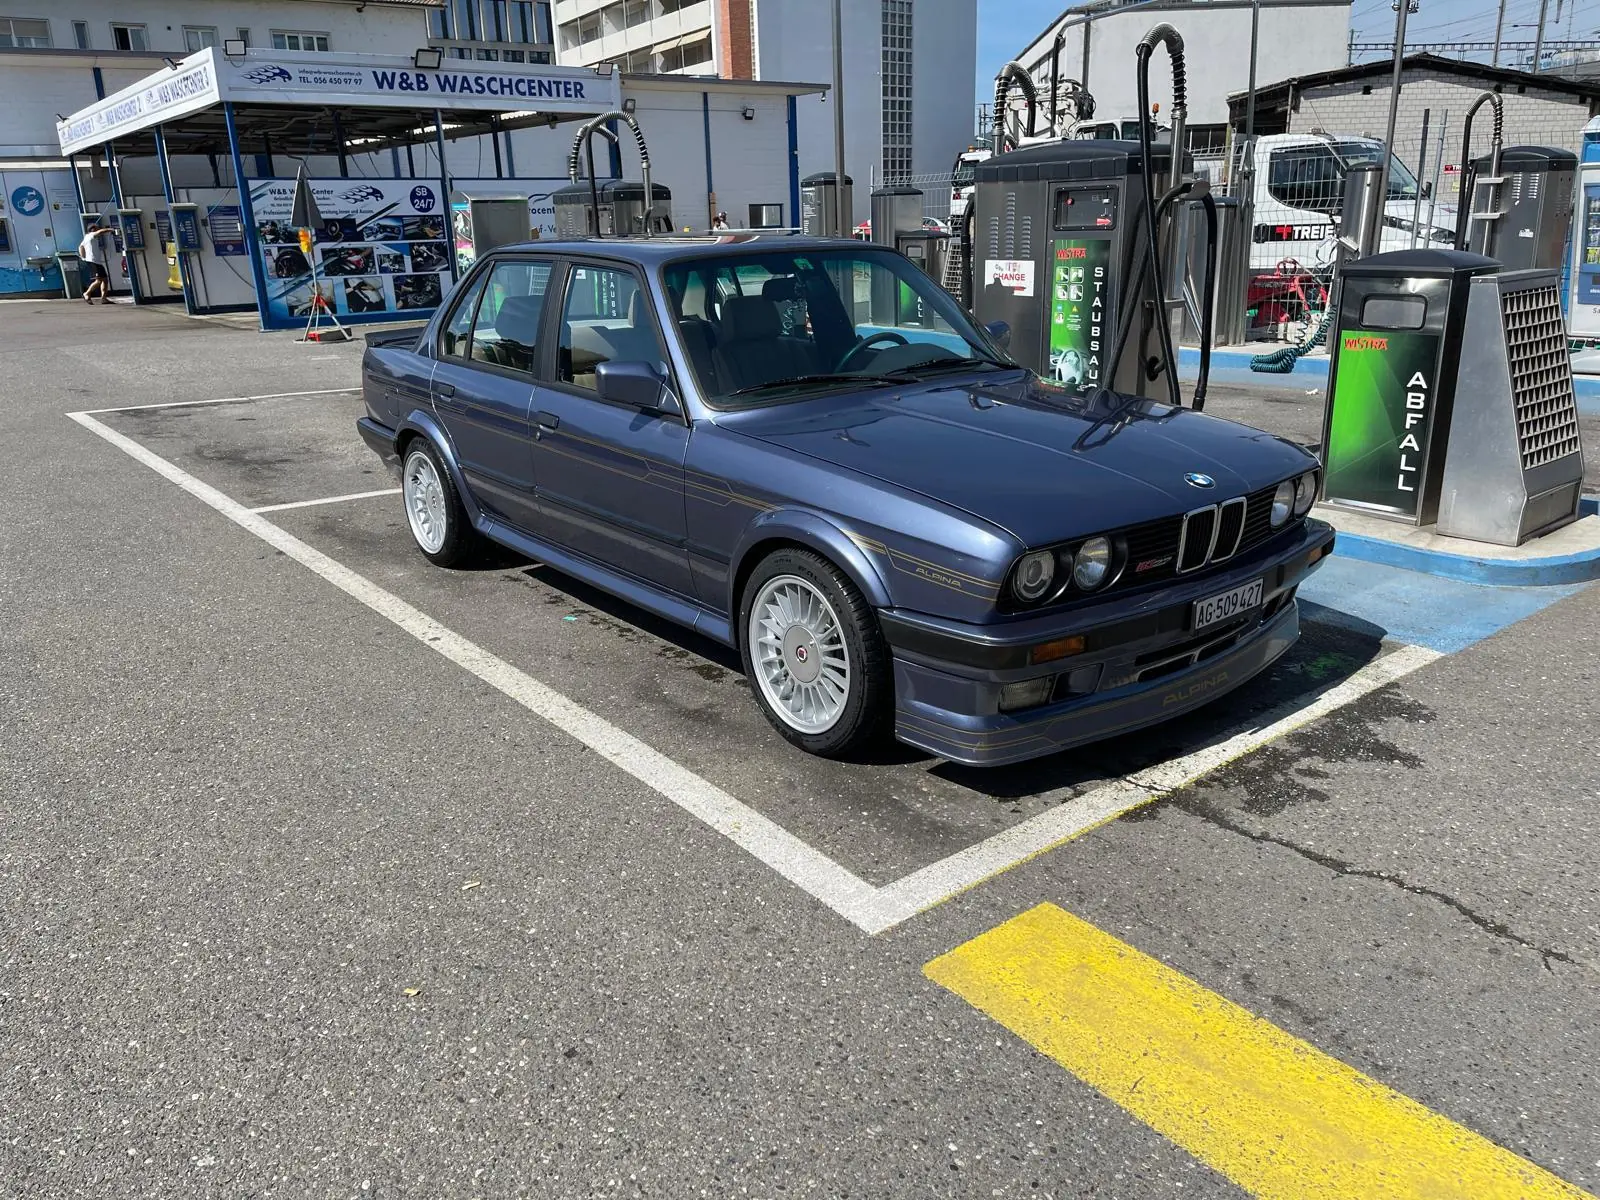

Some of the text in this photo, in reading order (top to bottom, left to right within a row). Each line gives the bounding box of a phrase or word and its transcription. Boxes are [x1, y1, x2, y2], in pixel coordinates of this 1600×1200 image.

[299, 76, 312, 84] TEL.
[329, 77, 342, 85] 450
[372, 70, 586, 99] W&B WASCHCENTER
[415, 187, 428, 196] SB
[414, 199, 434, 209] 24/7
[993, 273, 1026, 281] CHANGE
[1344, 337, 1389, 351] WISTRA
[1397, 371, 1428, 492] ABFALL
[915, 567, 962, 589] ALPINA
[1162, 671, 1229, 707] ALPINA
